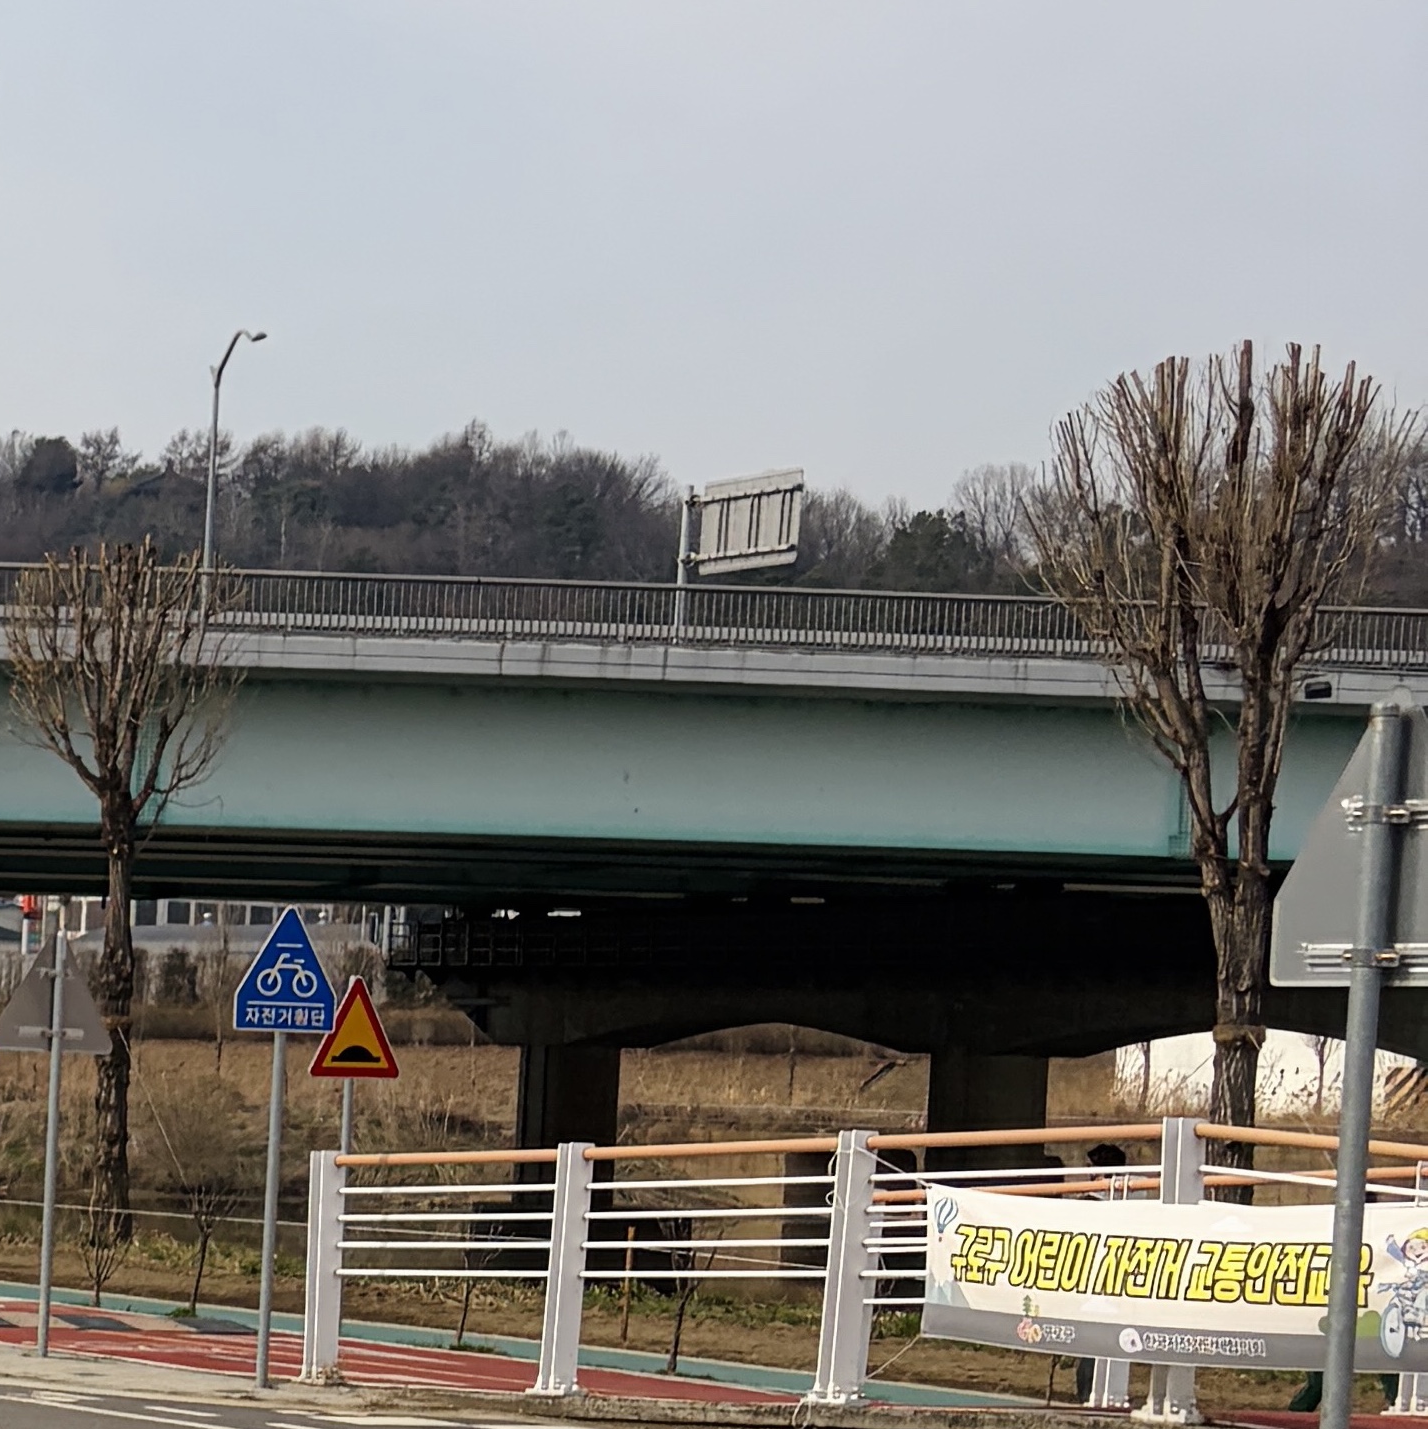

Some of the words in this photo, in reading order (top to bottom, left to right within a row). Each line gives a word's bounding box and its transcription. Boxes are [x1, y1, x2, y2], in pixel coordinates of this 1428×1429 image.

[950, 1224, 1011, 1284] 구로구
[1010, 1228, 1098, 1294] 어린이
[1096, 1233, 1194, 1300] 자전거
